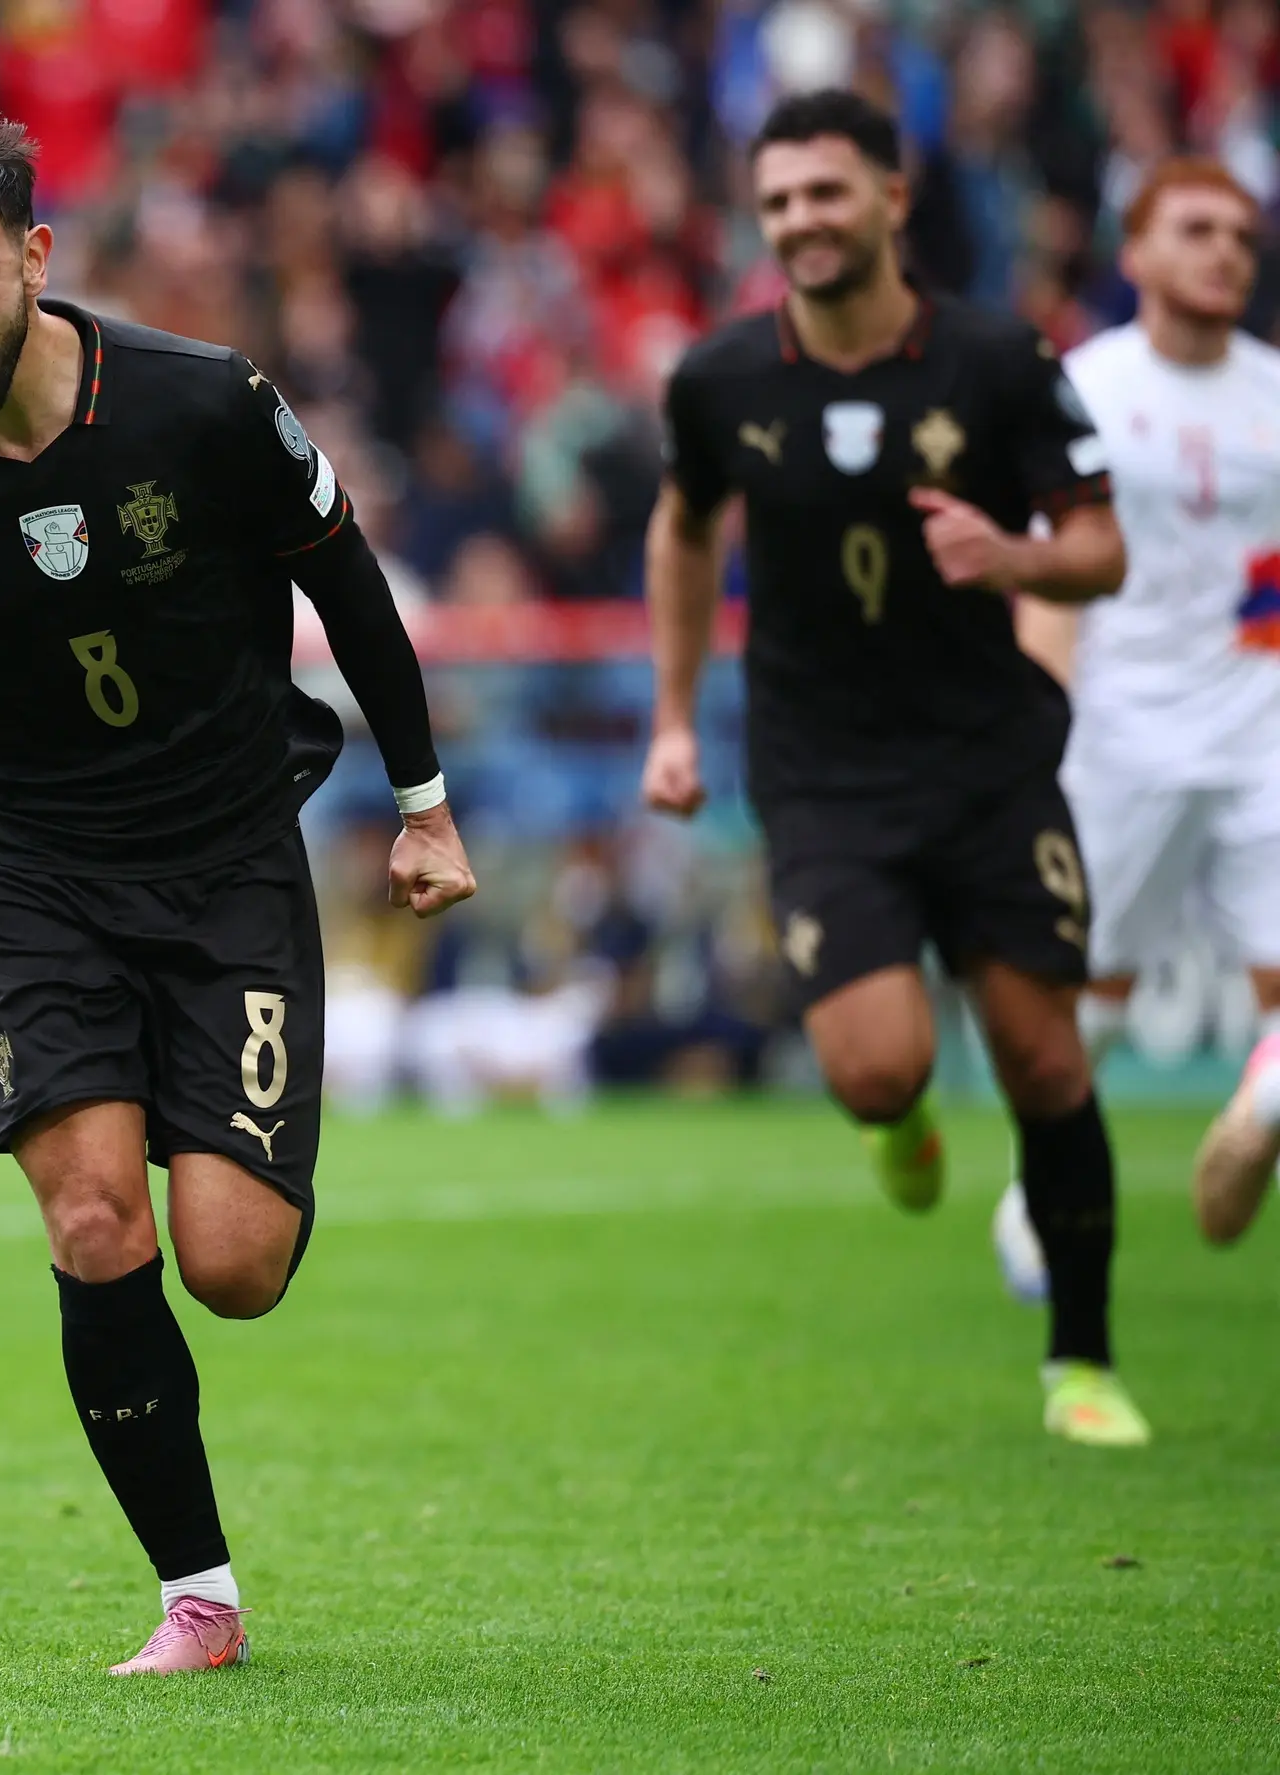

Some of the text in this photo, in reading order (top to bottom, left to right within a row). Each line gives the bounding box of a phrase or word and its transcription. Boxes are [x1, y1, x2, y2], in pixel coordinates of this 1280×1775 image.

[22, 516, 35, 524] UEFA
[35, 509, 58, 519] NATIONS
[134, 563, 174, 584] NOVEMBRO
[841, 523, 886, 625] 9
[68, 629, 139, 727] 8
[1032, 827, 1083, 912] 9
[241, 991, 287, 1109] 8
